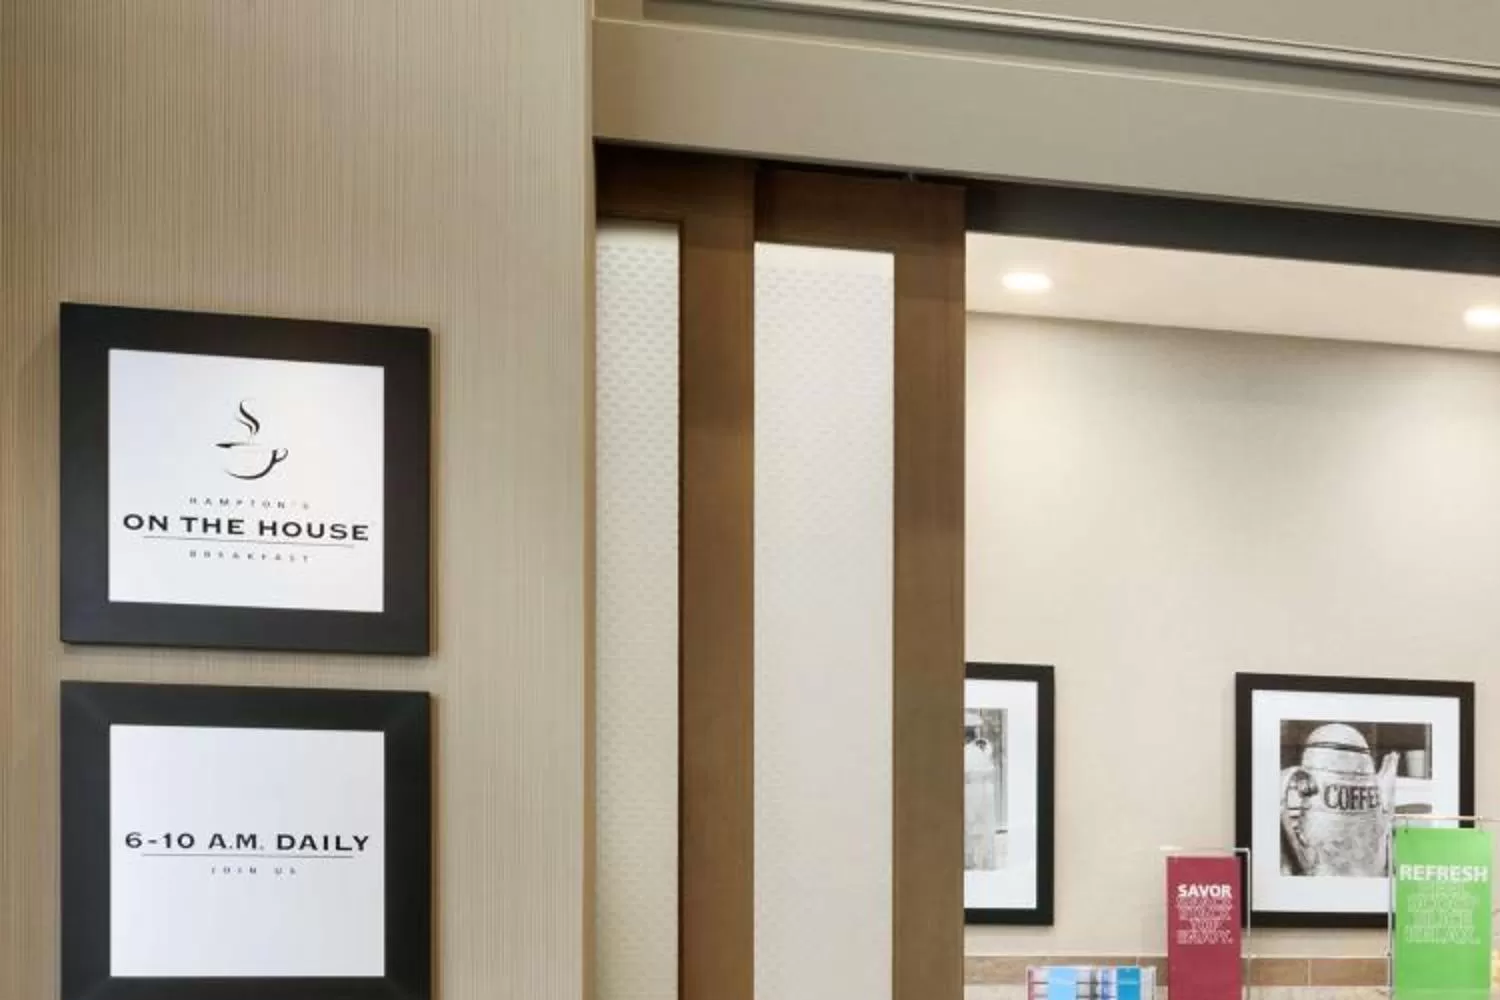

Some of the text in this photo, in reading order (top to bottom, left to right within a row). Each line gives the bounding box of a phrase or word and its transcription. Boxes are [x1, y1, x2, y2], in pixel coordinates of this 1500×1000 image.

[123, 513, 369, 541] ON THE HOUSE
[188, 549, 309, 563] BREAKFAST
[124, 831, 370, 852] 6-10 A.M. DAILY
[1399, 863, 1489, 883] REFRESH
[1176, 882, 1233, 898] SAVOR
